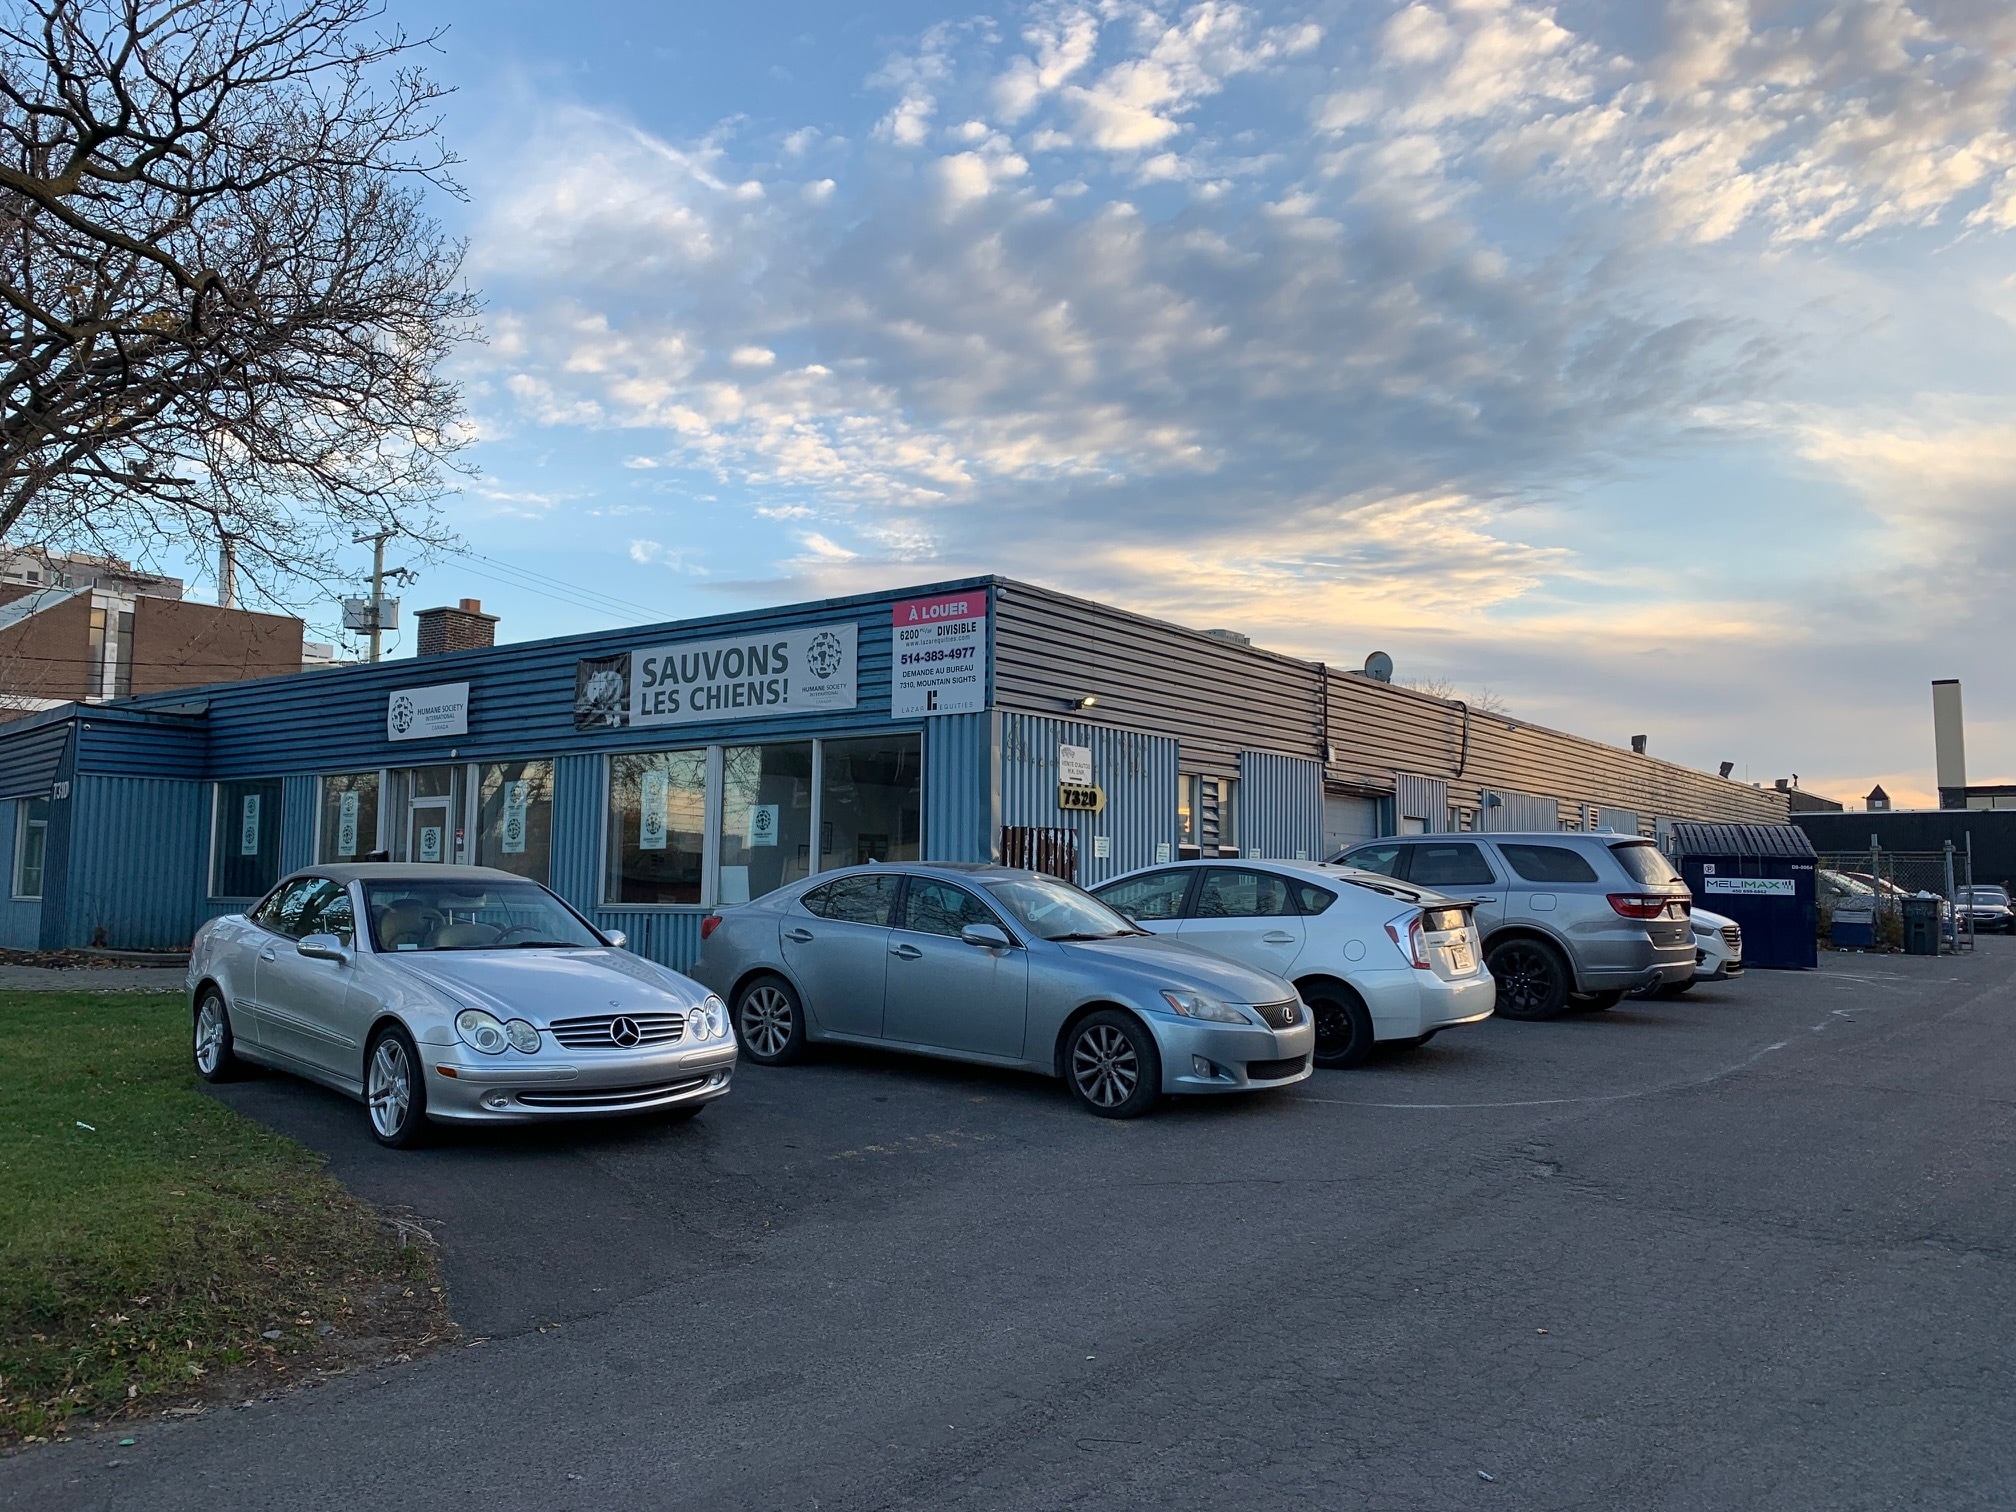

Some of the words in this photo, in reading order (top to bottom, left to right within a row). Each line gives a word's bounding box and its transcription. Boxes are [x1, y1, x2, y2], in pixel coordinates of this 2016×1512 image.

[908, 605, 918, 621] À
[922, 602, 968, 619] LOUER
[900, 629, 920, 641] 6200
[937, 622, 977, 637] DIVISIBLE
[905, 634, 971, 647] www.lazarequities.com
[900, 647, 976, 665] 514-383-4977
[641, 642, 789, 688] SAUVONS
[902, 667, 934, 678] DEMANDE
[935, 666, 945, 674] AU
[946, 664, 974, 674] BUREAU
[801, 685, 825, 693] HUMANE
[900, 681, 915, 690] 7310,
[916, 678, 951, 688] MOUNTAIN
[952, 675, 976, 684] SIGHTS
[640, 689, 680, 716] LES
[689, 678, 789, 712] CHIENS!
[417, 706, 441, 716] HUMANE
[442, 703, 464, 713] SOCIETY
[901, 705, 925, 714] LAZAR
[939, 701, 974, 711] EQUITIES
[425, 713, 455, 722] INTERNATIONAL
[1063, 789, 1097, 807] 7320
[1706, 880, 1780, 889] MELIMAX
